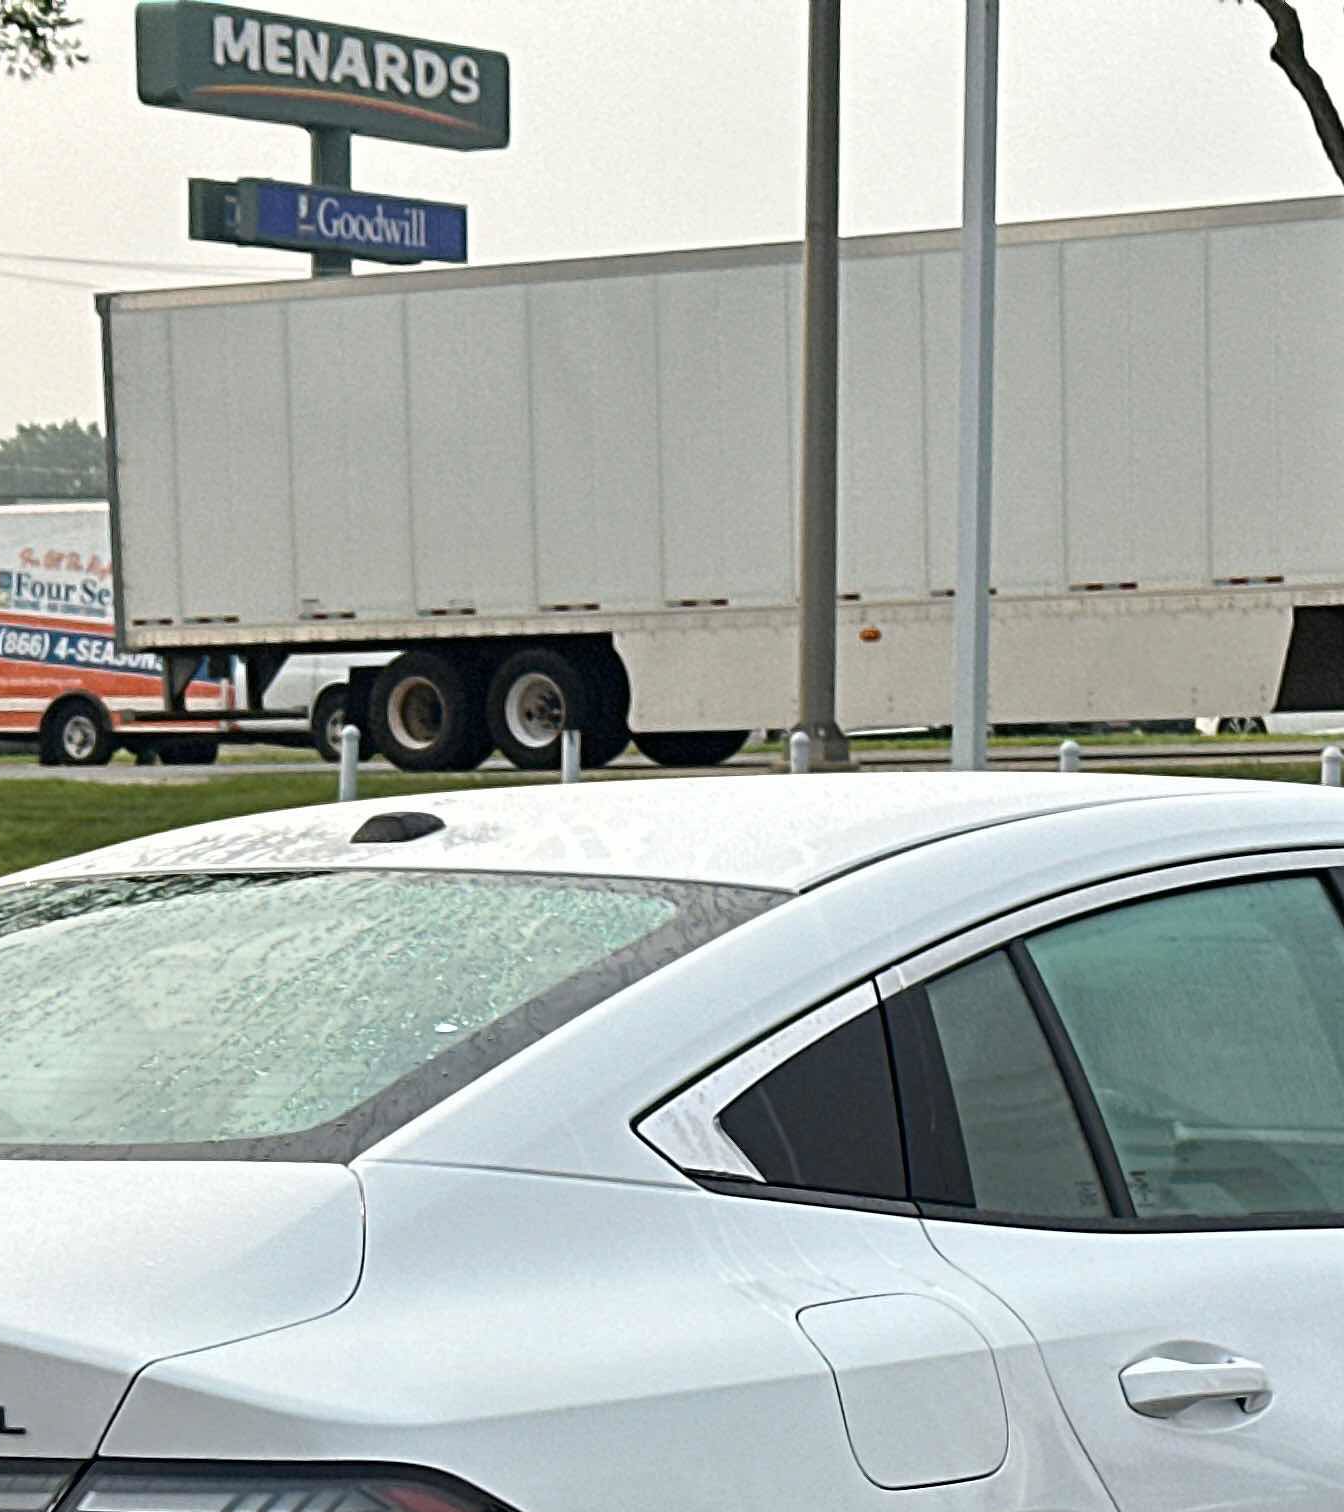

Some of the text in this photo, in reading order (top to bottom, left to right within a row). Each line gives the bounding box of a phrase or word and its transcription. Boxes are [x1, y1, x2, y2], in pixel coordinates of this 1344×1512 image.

[211, 15, 481, 104] MENARDS
[317, 197, 427, 247] Goodwill
[16, 571, 77, 602] Four
